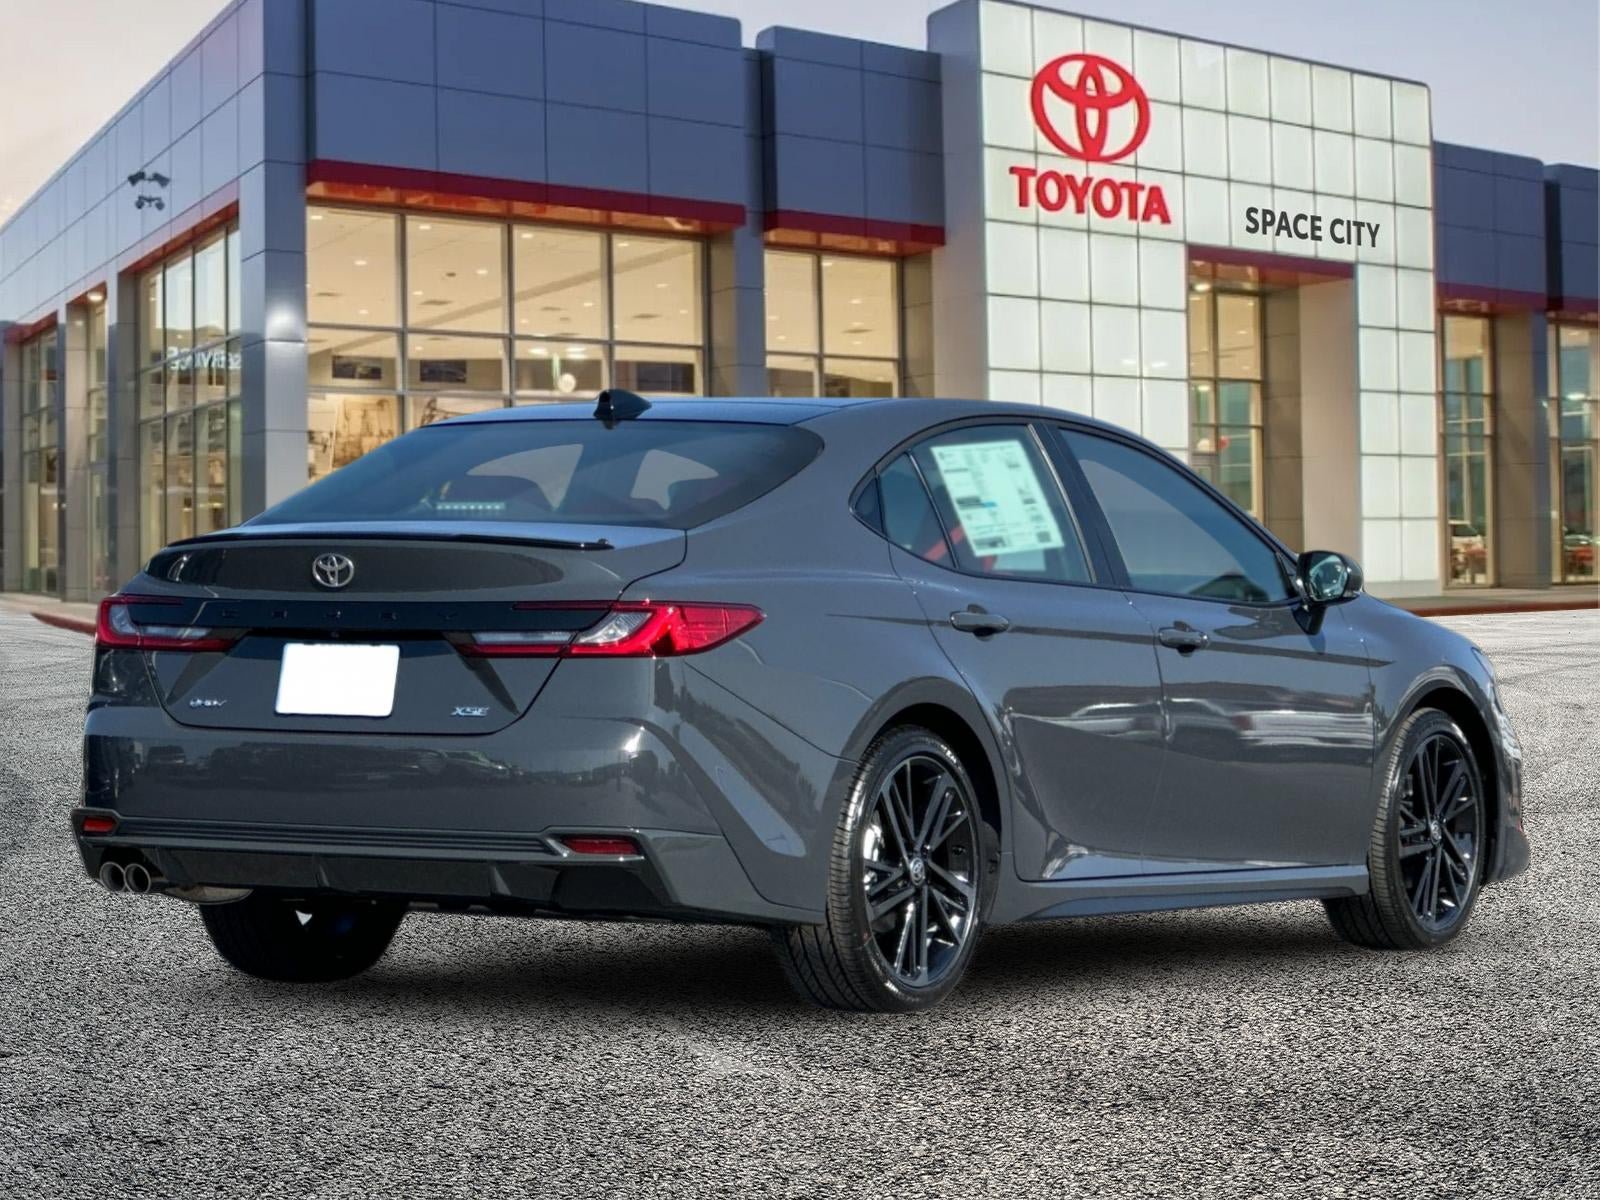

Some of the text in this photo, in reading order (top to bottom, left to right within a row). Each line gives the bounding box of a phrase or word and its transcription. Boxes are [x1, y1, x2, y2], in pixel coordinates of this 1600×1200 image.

[1009, 166, 1171, 224] TOYOTA
[1245, 206, 1381, 248] SPACE CITY
